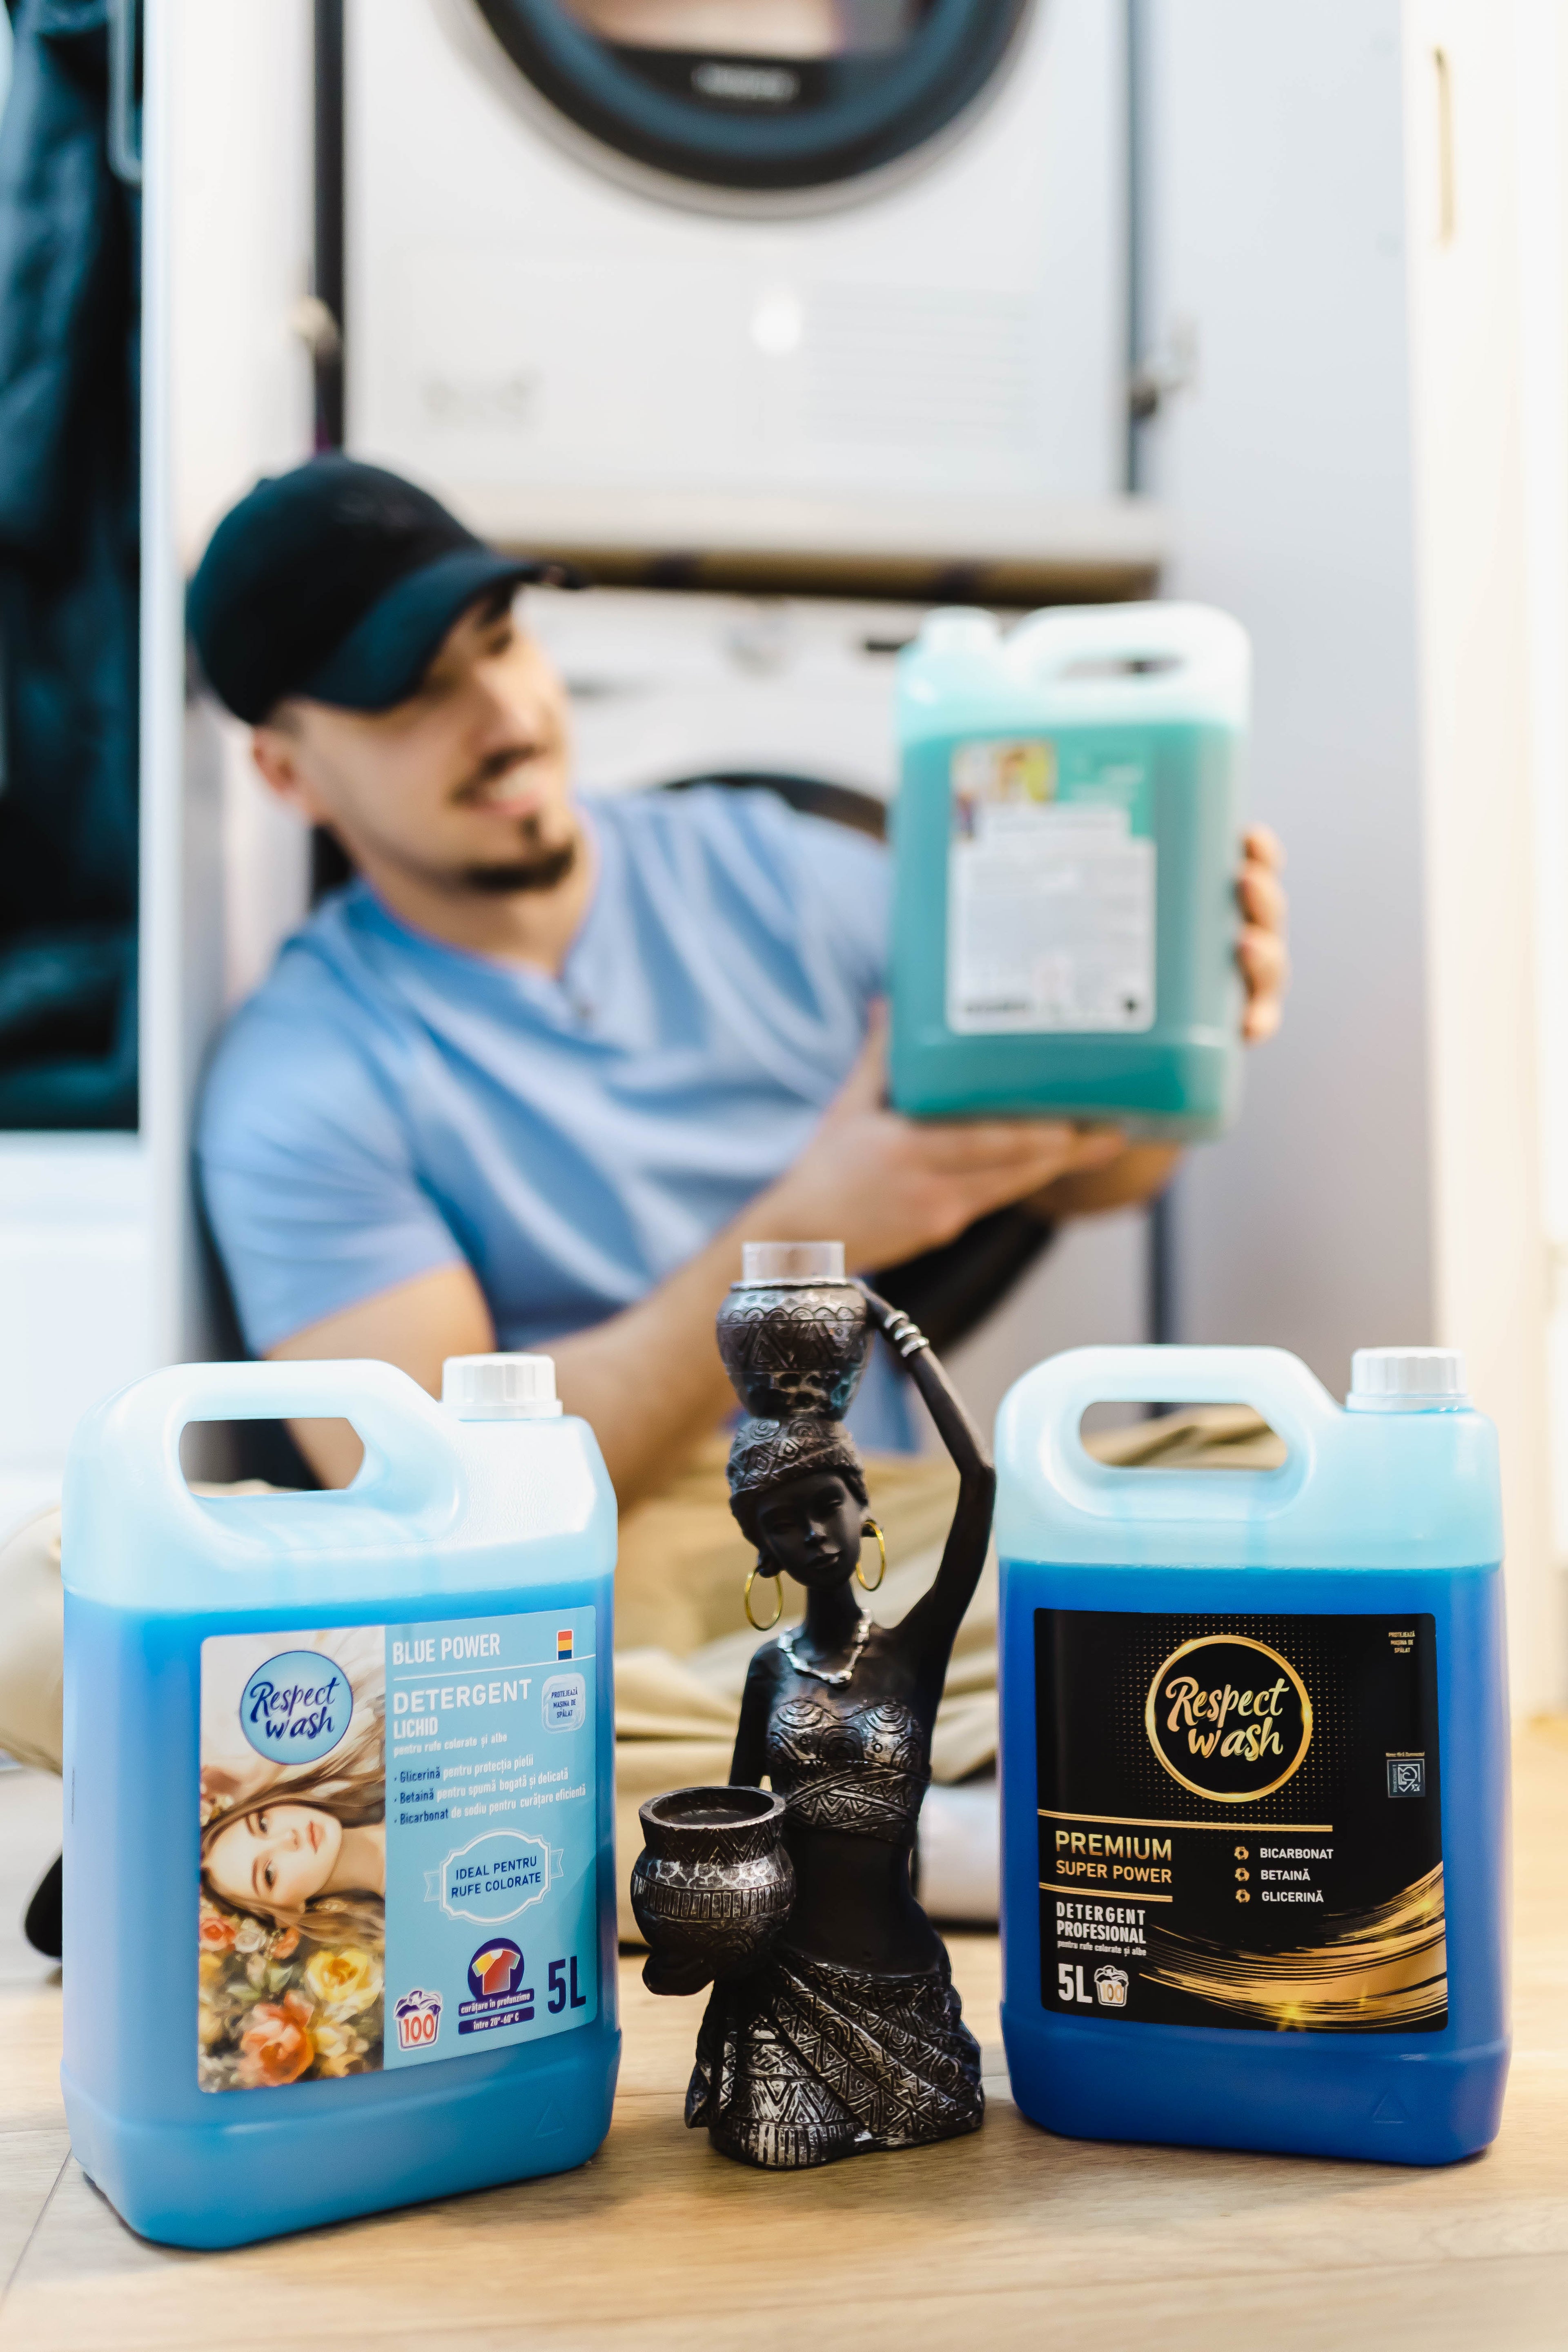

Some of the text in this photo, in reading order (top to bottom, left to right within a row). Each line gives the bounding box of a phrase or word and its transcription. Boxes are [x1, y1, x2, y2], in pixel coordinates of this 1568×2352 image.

[393, 1633, 500, 1665] BLUE POWER
[249, 1676, 340, 1723] Respect
[393, 1679, 532, 1714] DETERGENT
[1166, 1676, 1290, 1732] Respect
[266, 1706, 334, 1740] wash
[393, 1716, 438, 1740] LICHID
[393, 1744, 422, 1758] pentru
[1188, 1717, 1283, 1762] wash
[400, 1754, 534, 1783] Glicerină pentru protecția pielii
[400, 1766, 568, 1804] Betaină pentru spumă bogată și delicată
[400, 1808, 448, 1825] Bicarbonat
[451, 1806, 462, 1818] de
[464, 1802, 487, 1816] sodiu
[489, 1799, 516, 1816] pentru
[520, 1792, 553, 1809] curățare
[1056, 1830, 1172, 1861] PREMIUM
[1260, 1848, 1334, 1859] BICARBONAT
[456, 1855, 537, 1880] IDEAL PENTRU
[1056, 1860, 1172, 1883] SUPER POWER
[1261, 1868, 1310, 1880] BETAINĂ
[451, 1871, 541, 1899] RUFE COLORATE
[1262, 1890, 1324, 1902] GLICERINĂ
[1056, 1902, 1145, 1925] DETERGENT
[1057, 1920, 1146, 1944] PROFESIONAL
[548, 1955, 586, 2014] 5L
[1058, 1963, 1093, 2003] 5L
[1102, 1983, 1123, 2002] 100
[403, 2014, 434, 2043] 100
